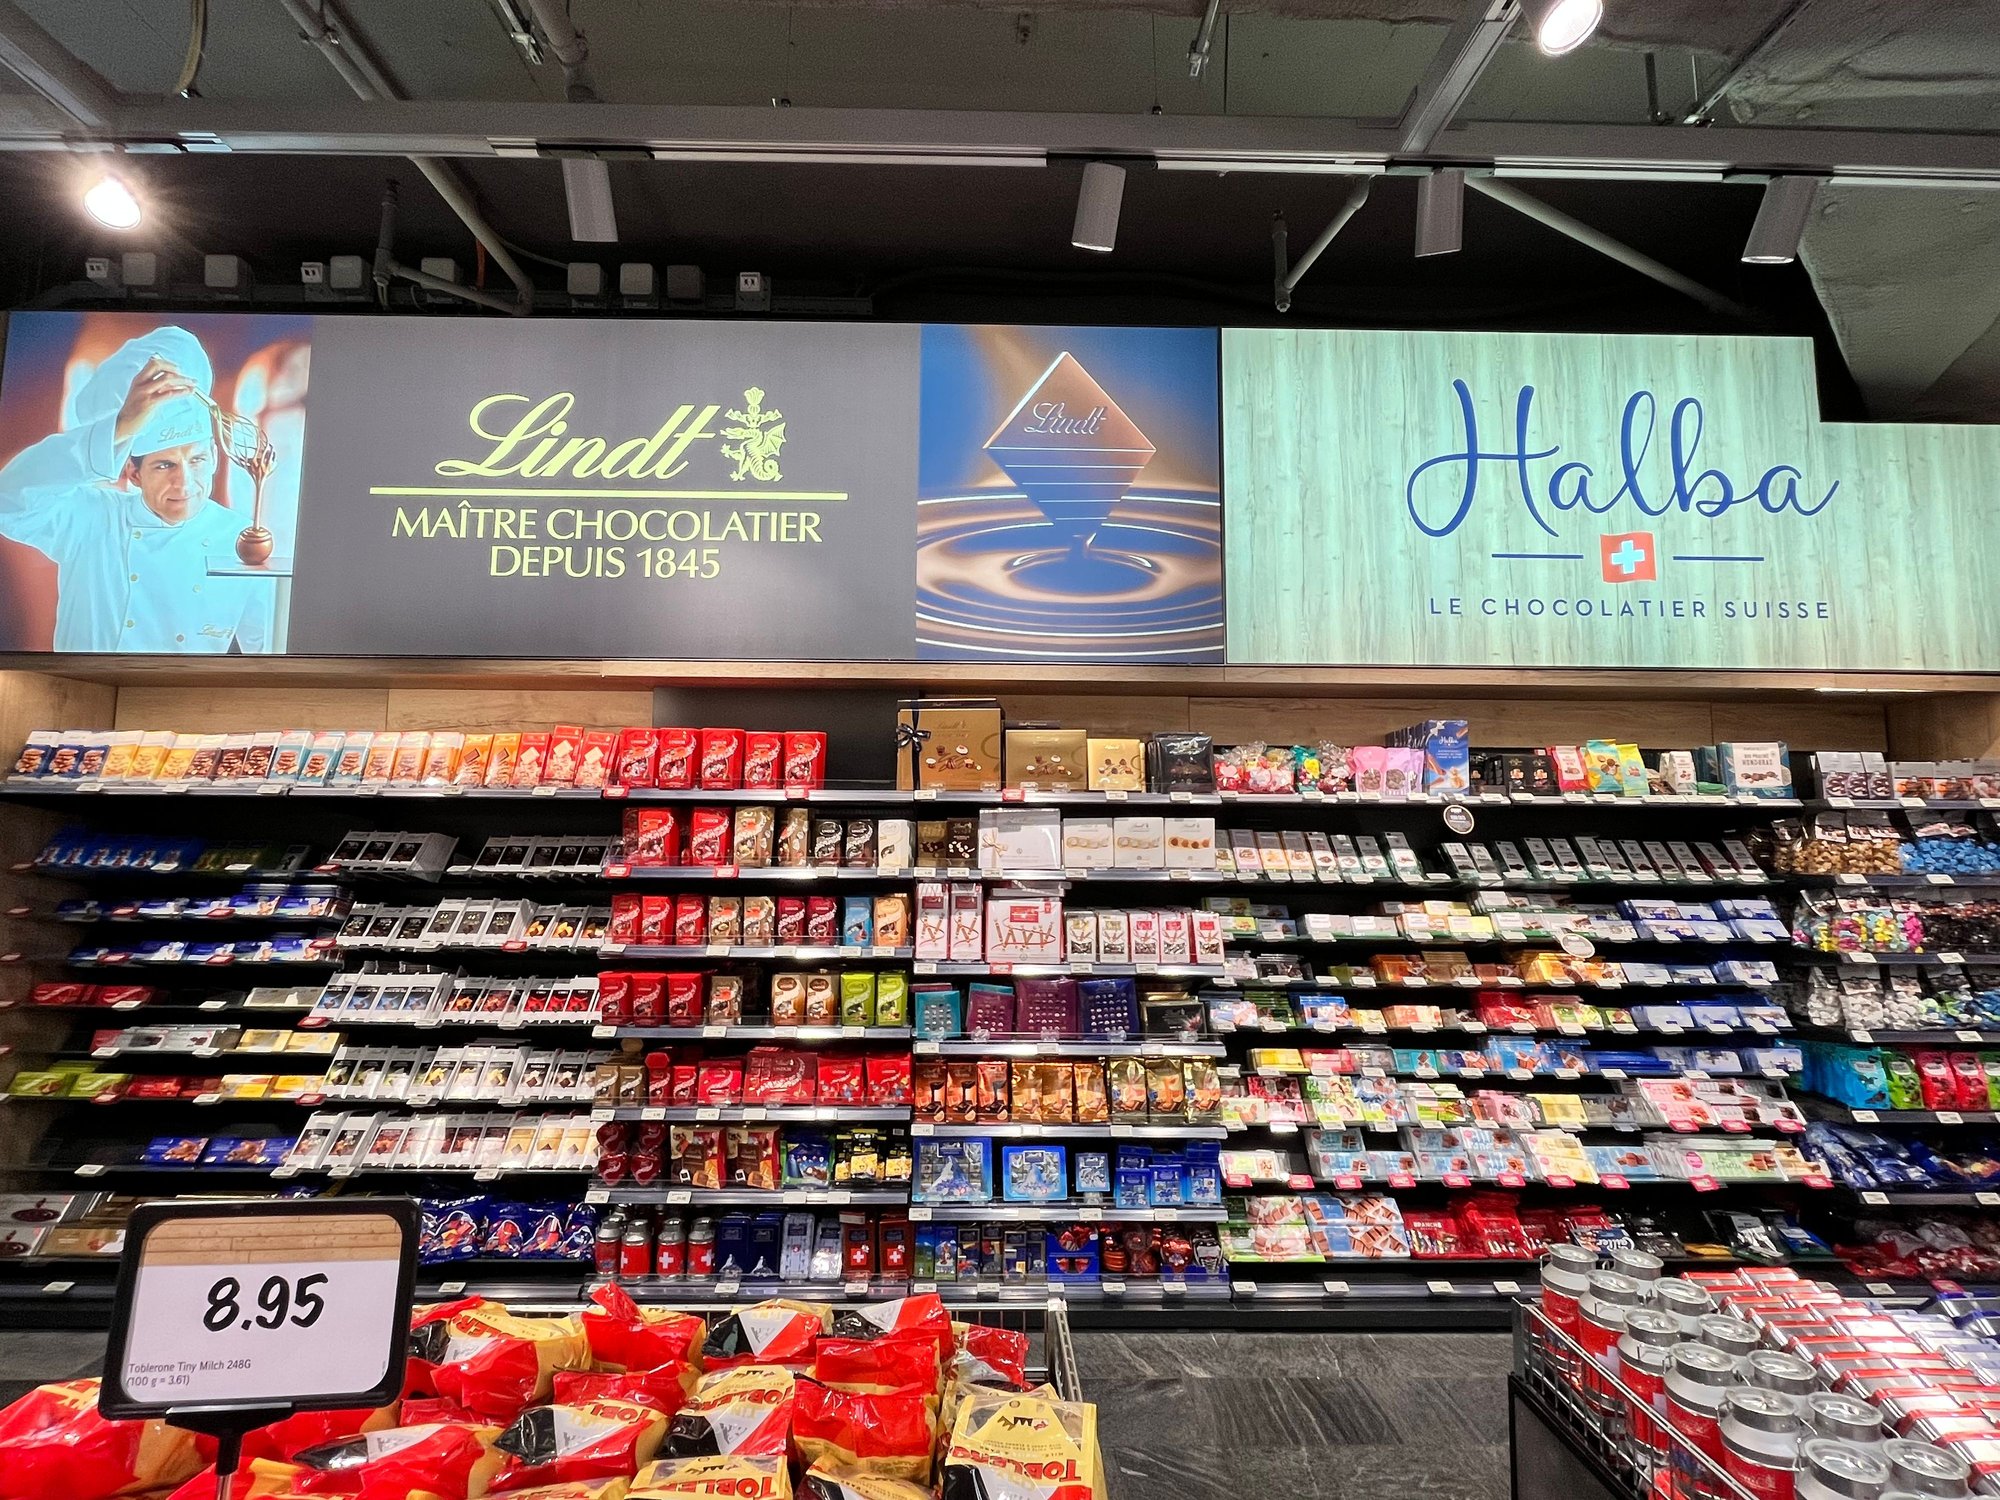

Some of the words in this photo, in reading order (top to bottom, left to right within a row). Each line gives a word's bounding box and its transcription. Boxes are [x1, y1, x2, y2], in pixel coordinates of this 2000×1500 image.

[434, 391, 722, 479] Lindt
[1023, 402, 1107, 435] Lindt
[1406, 379, 1840, 537] Halba
[392, 499, 538, 539] MAÎTRE
[545, 506, 823, 543] CHOCOLATIER
[489, 545, 627, 578] DEPUIS
[635, 547, 721, 579] 1845
[1430, 597, 1463, 616] LE
[1481, 598, 1706, 618] CHOCOLATIER
[1724, 601, 1830, 619] SUISSE
[203, 1272, 328, 1332] 8.95
[126, 1376, 149, 1387] (100
[168, 1374, 190, 1386] 3.61)
[128, 1363, 176, 1374] Toblerone
[177, 1361, 198, 1374] Tiny
[200, 1359, 224, 1371] Milch
[226, 1358, 251, 1370] 248G
